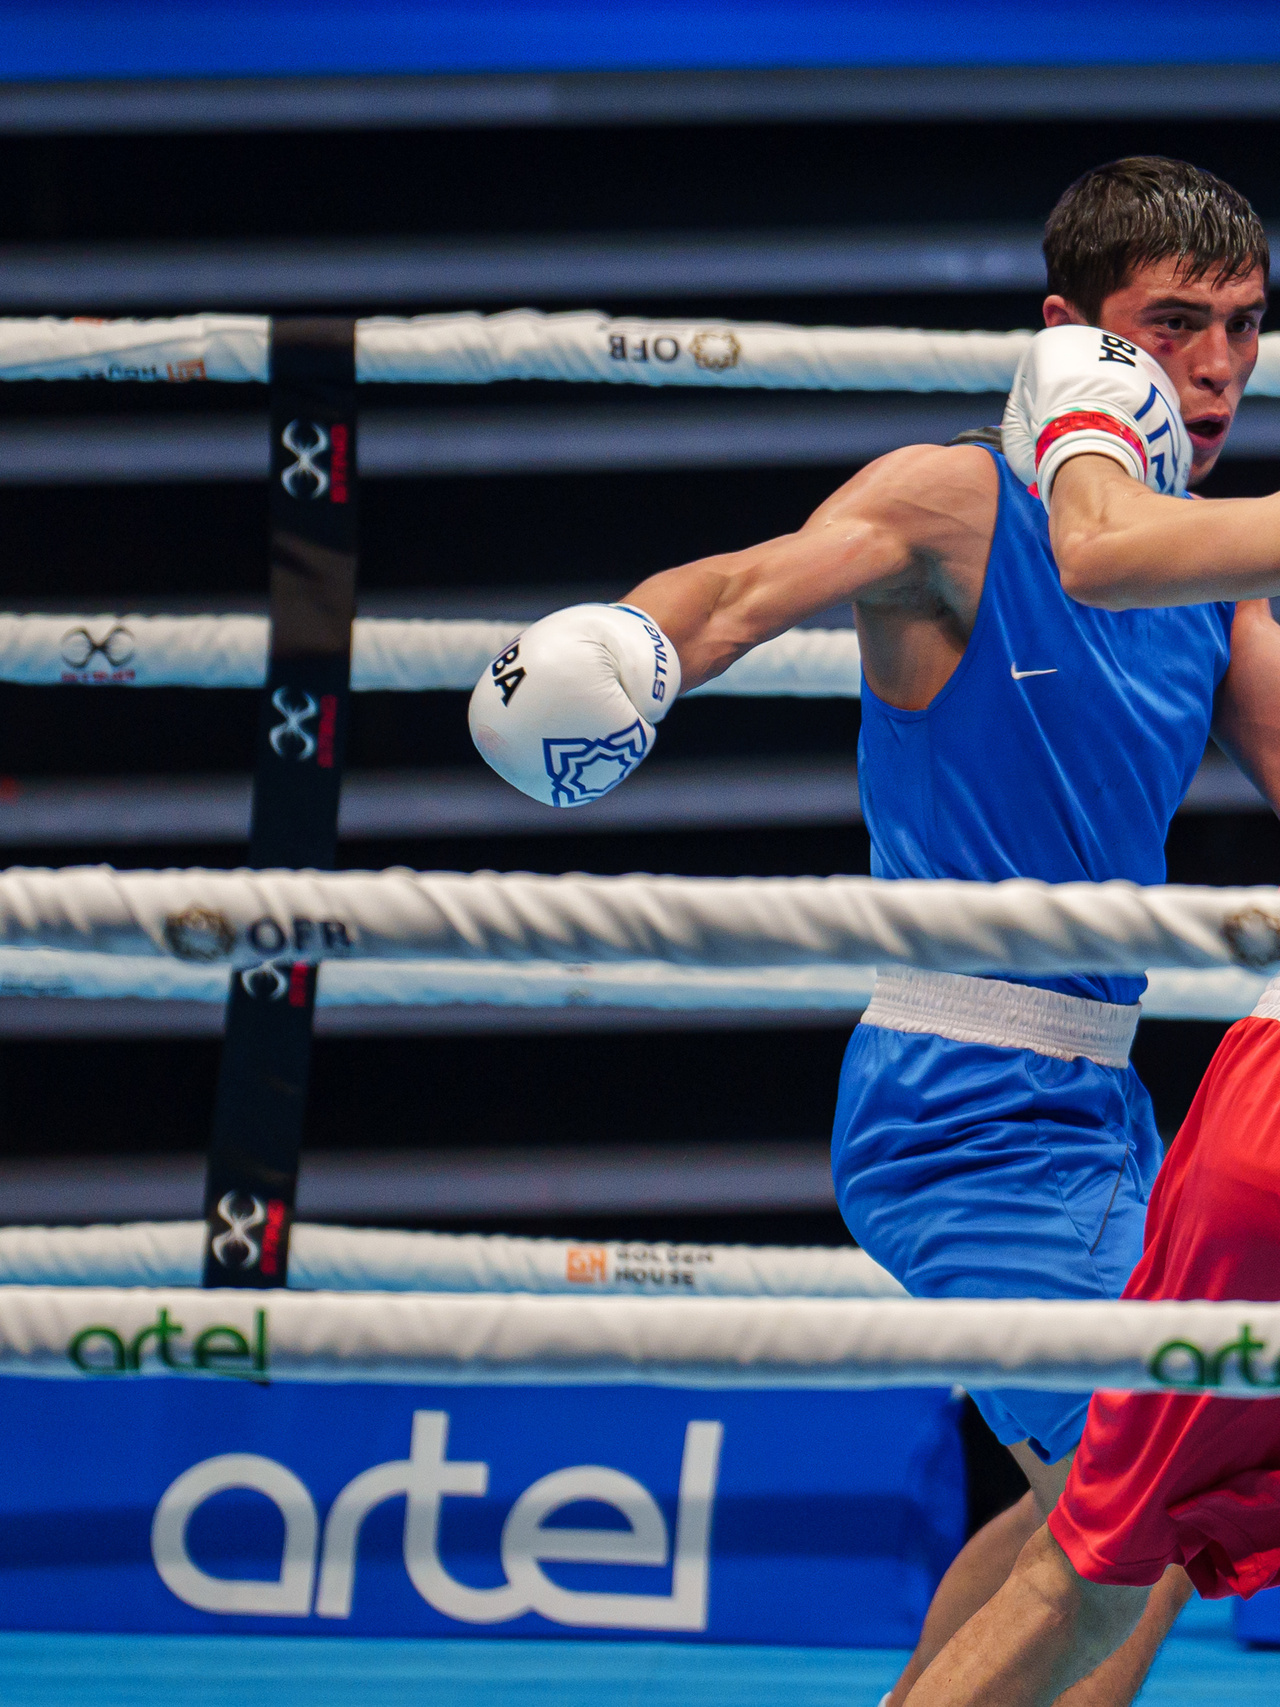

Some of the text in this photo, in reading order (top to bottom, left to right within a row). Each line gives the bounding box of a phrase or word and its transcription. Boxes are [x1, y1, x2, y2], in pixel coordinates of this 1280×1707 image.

[610, 333, 680, 363] OFB
[1099, 332, 1137, 368] BA
[491, 639, 528, 708] BA
[643, 624, 668, 703] STING
[68, 1307, 268, 1377] artel
[151, 1410, 723, 1632] artel
